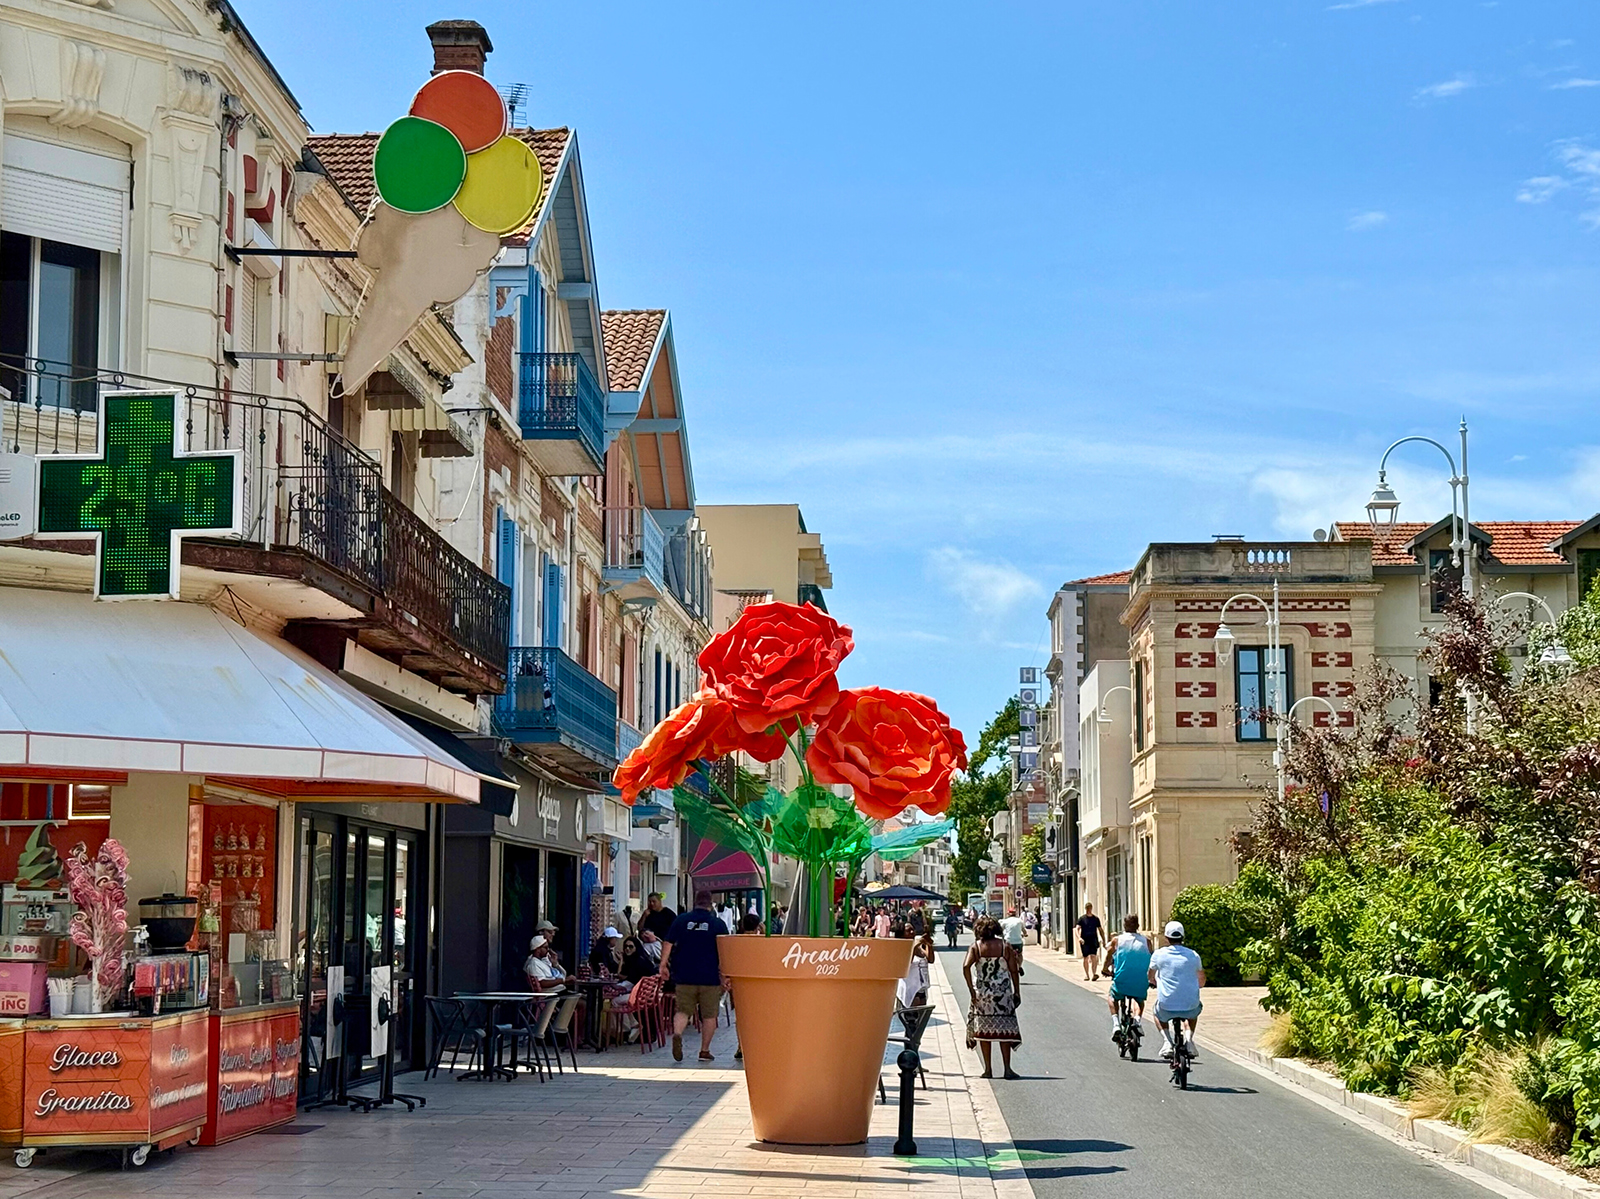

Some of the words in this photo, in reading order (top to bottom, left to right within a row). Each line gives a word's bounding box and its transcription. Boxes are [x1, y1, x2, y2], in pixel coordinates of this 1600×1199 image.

[0, 513, 21, 521] oLED
[1022, 669, 1034, 767] HOTEL
[14, 944, 42, 954] PAPA
[782, 941, 870, 969] Arcachon
[815, 964, 840, 976] 2025
[49, 1043, 122, 1071] Glaces
[34, 1088, 135, 1117] Granitas
[219, 1083, 265, 1114] Fabrication
